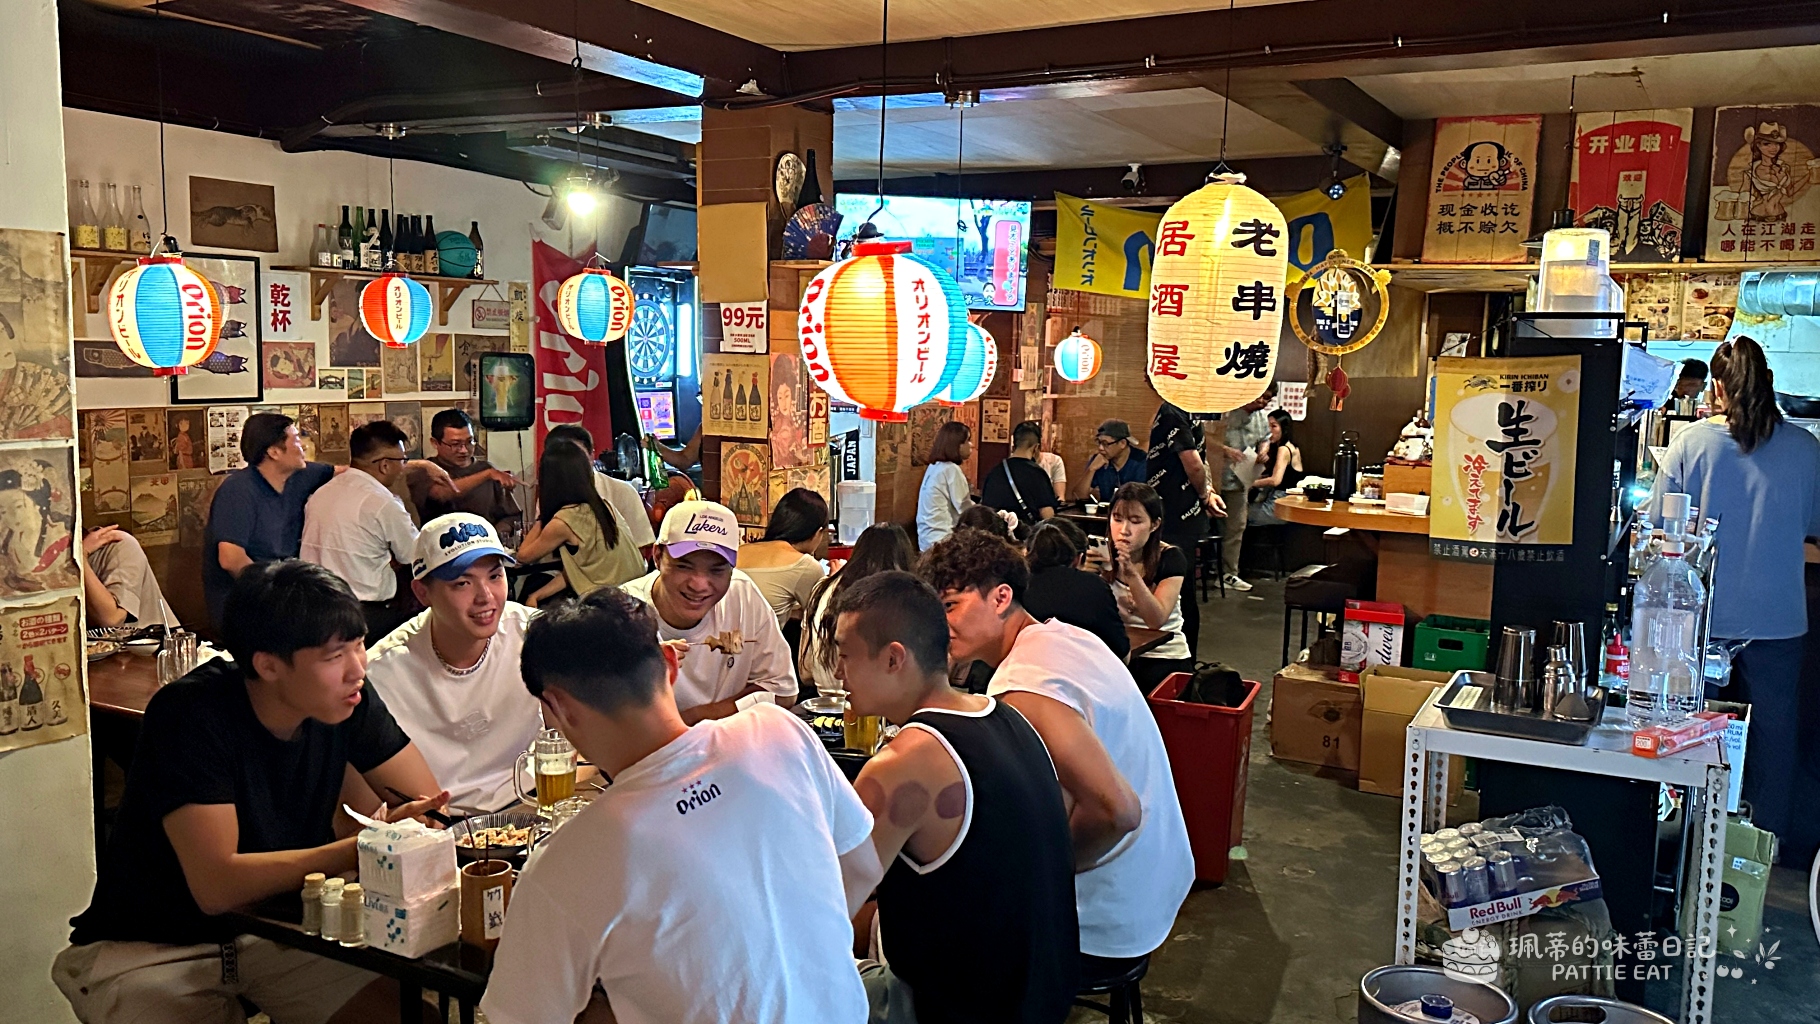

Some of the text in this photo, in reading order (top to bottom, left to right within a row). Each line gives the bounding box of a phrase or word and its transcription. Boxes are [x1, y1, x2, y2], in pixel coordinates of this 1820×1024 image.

[1519, 167, 1529, 192] CHINA
[1437, 203, 1521, 217] 现金收讫
[1436, 220, 1519, 235] 概不赊欠
[1721, 222, 1816, 237] 人在江湖走
[1720, 238, 1815, 252] 哪能不喝酒
[1360, 263, 1375, 275] YEAR
[270, 283, 292, 333] 乾杯
[394, 285, 403, 330] オリオンビール
[1150, 220, 1195, 381] 居酒屋
[1216, 218, 1280, 380] 老串燒
[722, 307, 765, 329] 99元
[910, 278, 931, 384] オリオンビール
[1499, 380, 1548, 392] 一番搾り
[809, 391, 827, 445] お酒
[846, 440, 857, 475] JAPAN
[1485, 400, 1542, 537] 生ビール
[1462, 454, 1489, 533] 冷えてます
[684, 513, 728, 536] Lakers
[1322, 735, 1340, 749] 81
[1470, 897, 1522, 920] Red Bull
[1471, 910, 1523, 926] ENERGY DRINK
